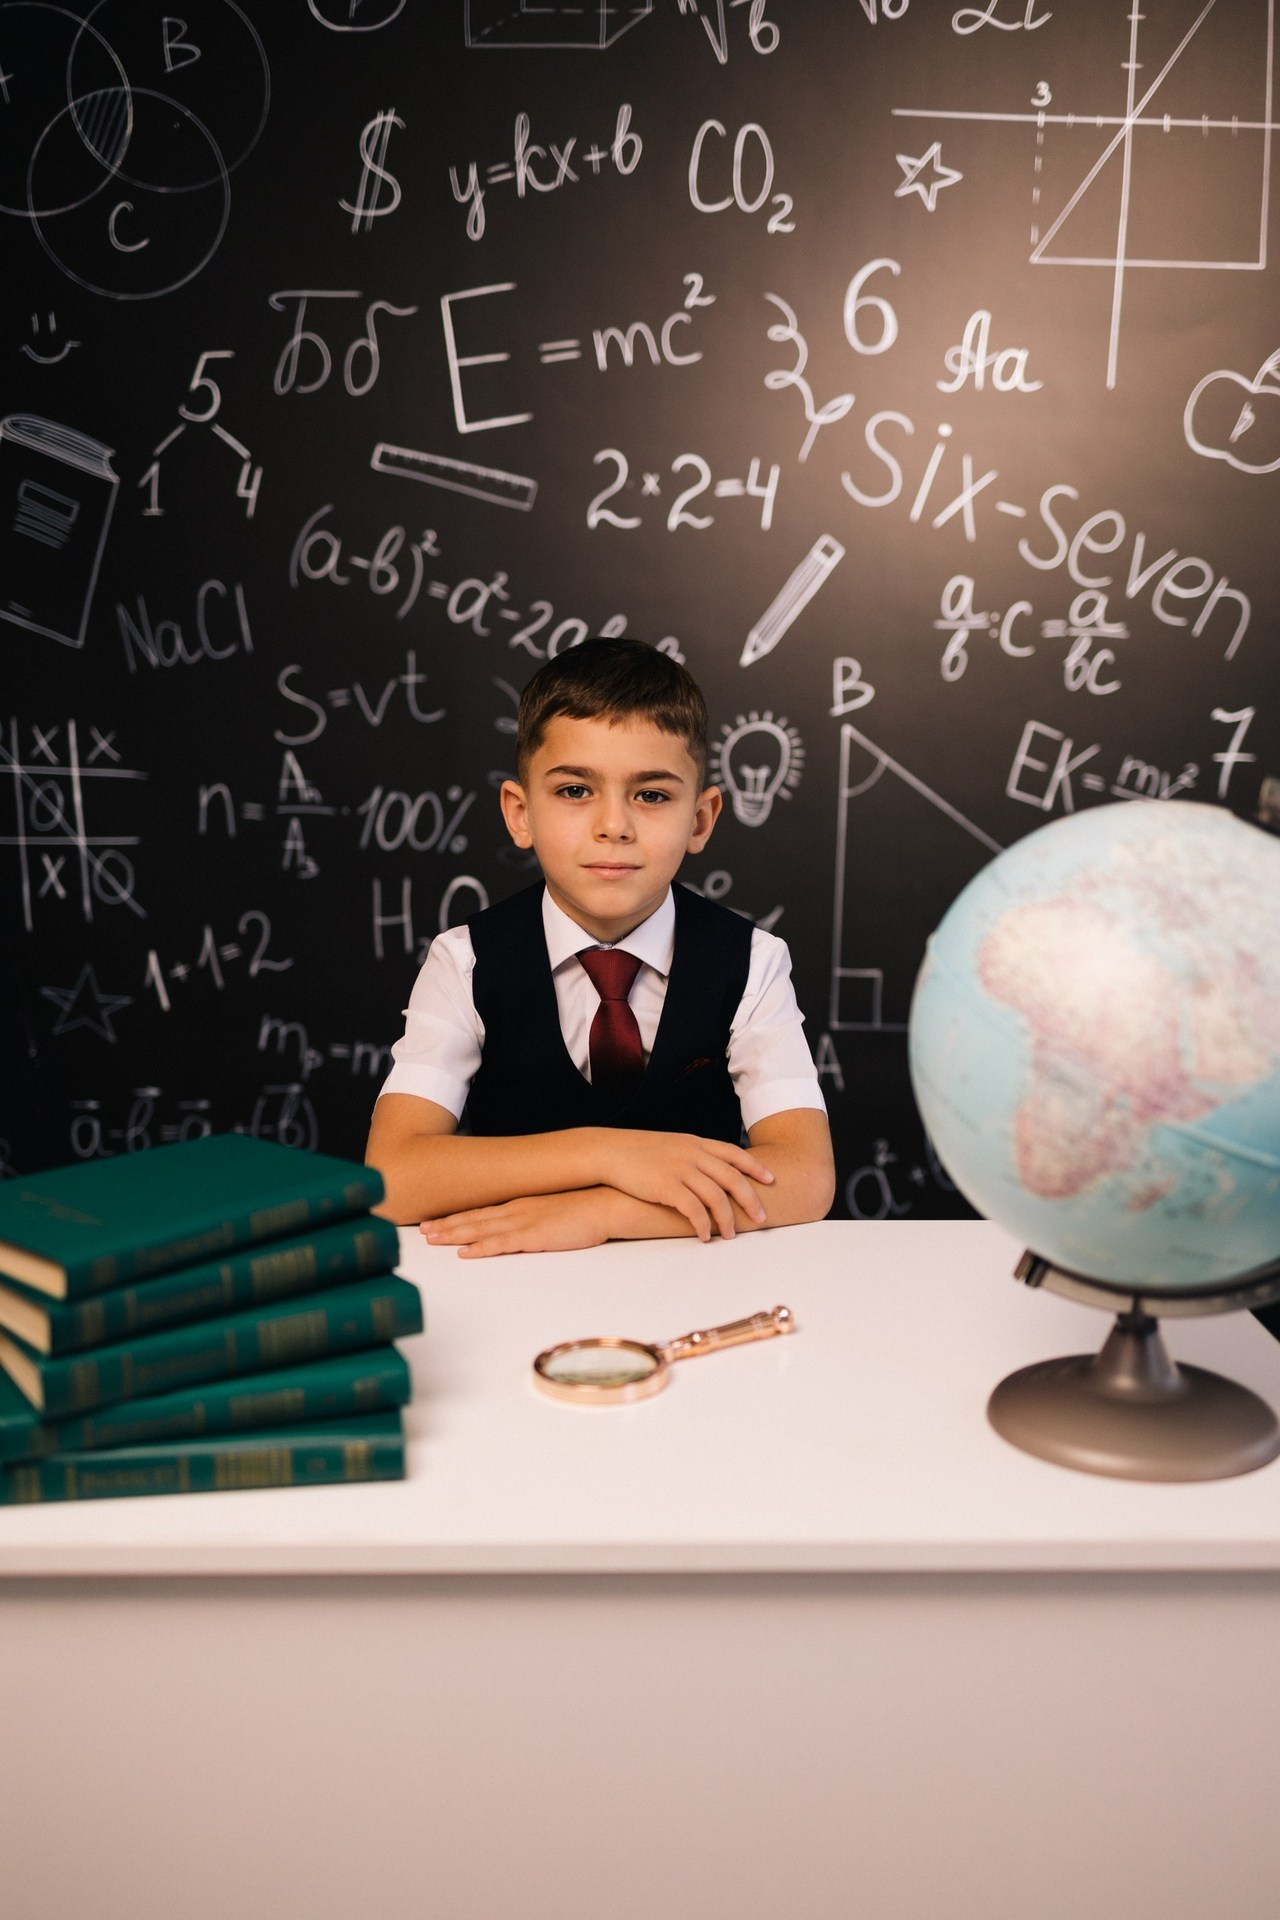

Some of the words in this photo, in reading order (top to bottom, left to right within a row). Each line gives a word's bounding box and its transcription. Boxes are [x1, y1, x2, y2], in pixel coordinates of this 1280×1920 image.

[161, 16, 201, 72] B
[1030, 80, 1053, 107] 3
[108, 200, 150, 253] C
[843, 257, 901, 356] 6
[178, 350, 235, 422] 5
[138, 460, 165, 516] 1
[236, 460, 263, 519] 4
[116, 578, 254, 674] NaCl
[828, 656, 876, 718] B
[1210, 706, 1257, 799] 7
